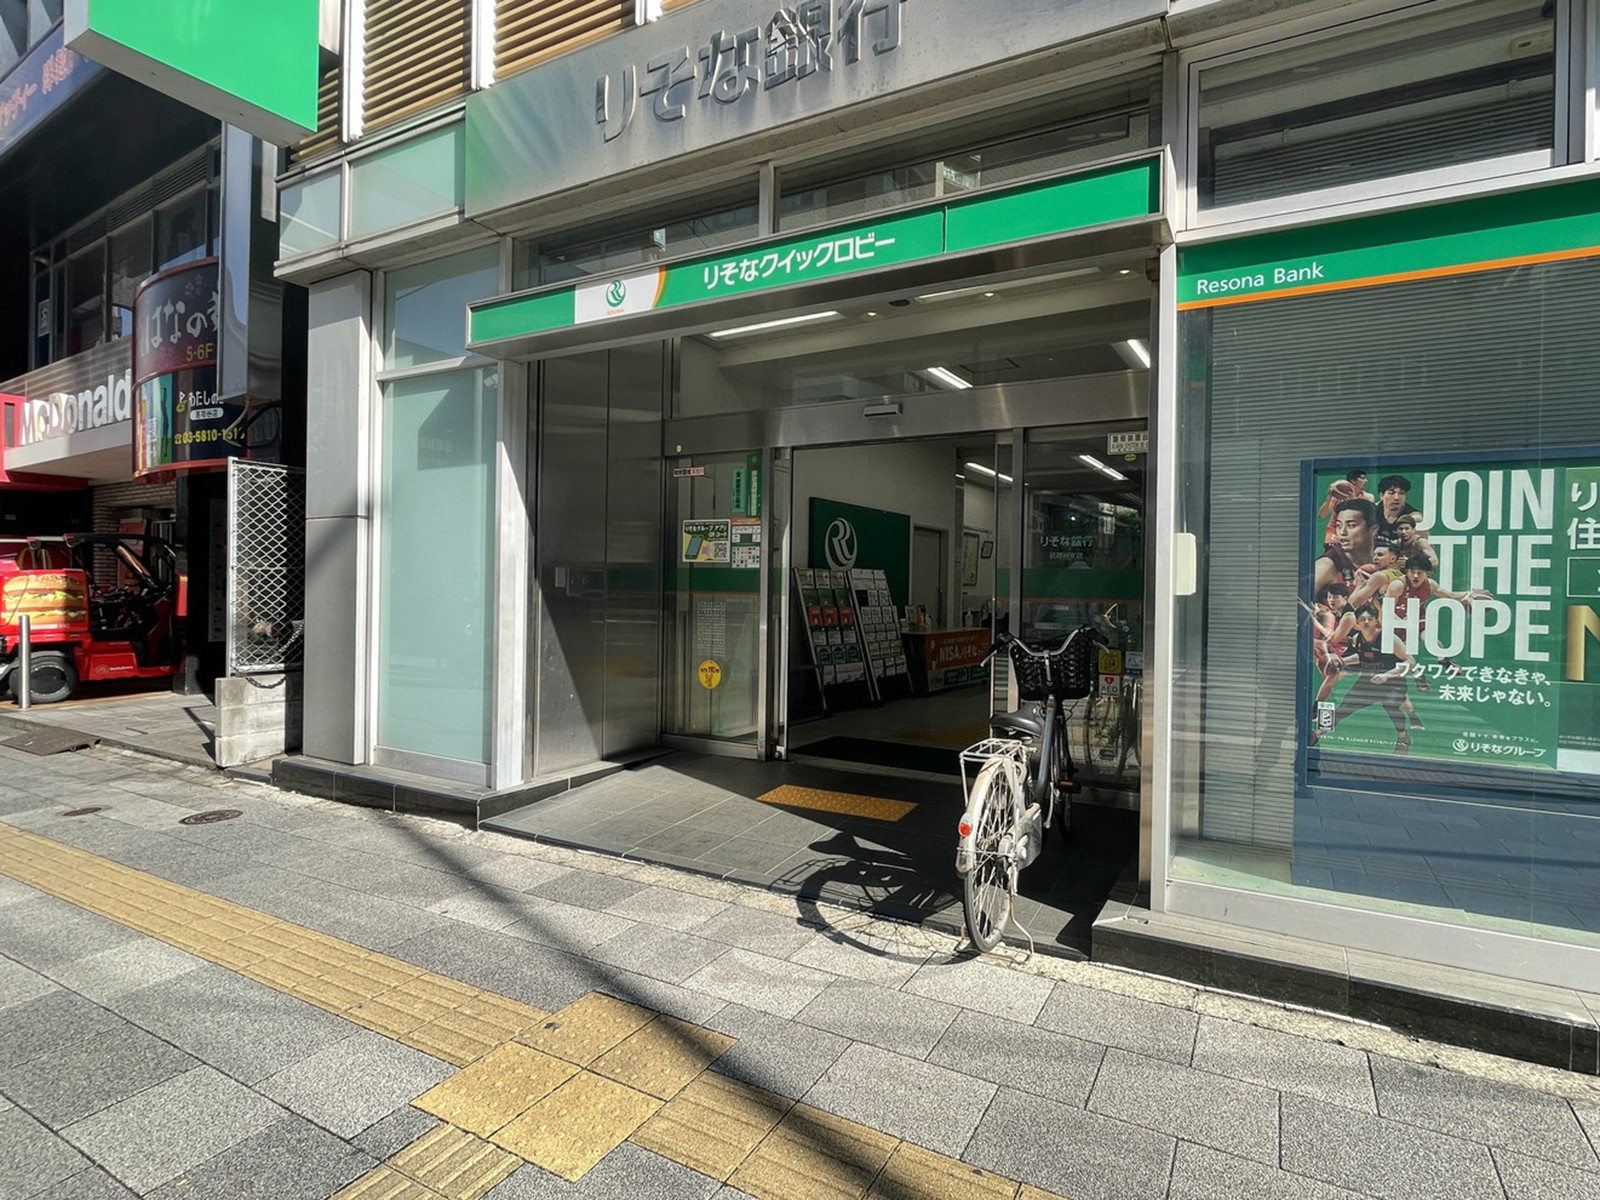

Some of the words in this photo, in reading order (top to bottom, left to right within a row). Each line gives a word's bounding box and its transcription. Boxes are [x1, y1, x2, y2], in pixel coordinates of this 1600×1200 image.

[595, 0, 907, 143] りそな銀行
[704, 234, 896, 290] りそなクイックロビー
[1196, 274, 1265, 296] Resona
[1273, 261, 1325, 285] Bank
[1415, 469, 1555, 531] JOIN
[1040, 535, 1094, 547] りそな銀行
[1427, 534, 1553, 596] THE
[1381, 597, 1551, 662] HOPE
[1100, 686, 1119, 694] AED
[1395, 661, 1552, 688] ワクワクできなきゃ、
[1438, 684, 1552, 708] 未来じゃない。
[1470, 742, 1547, 757] りそなグループ
